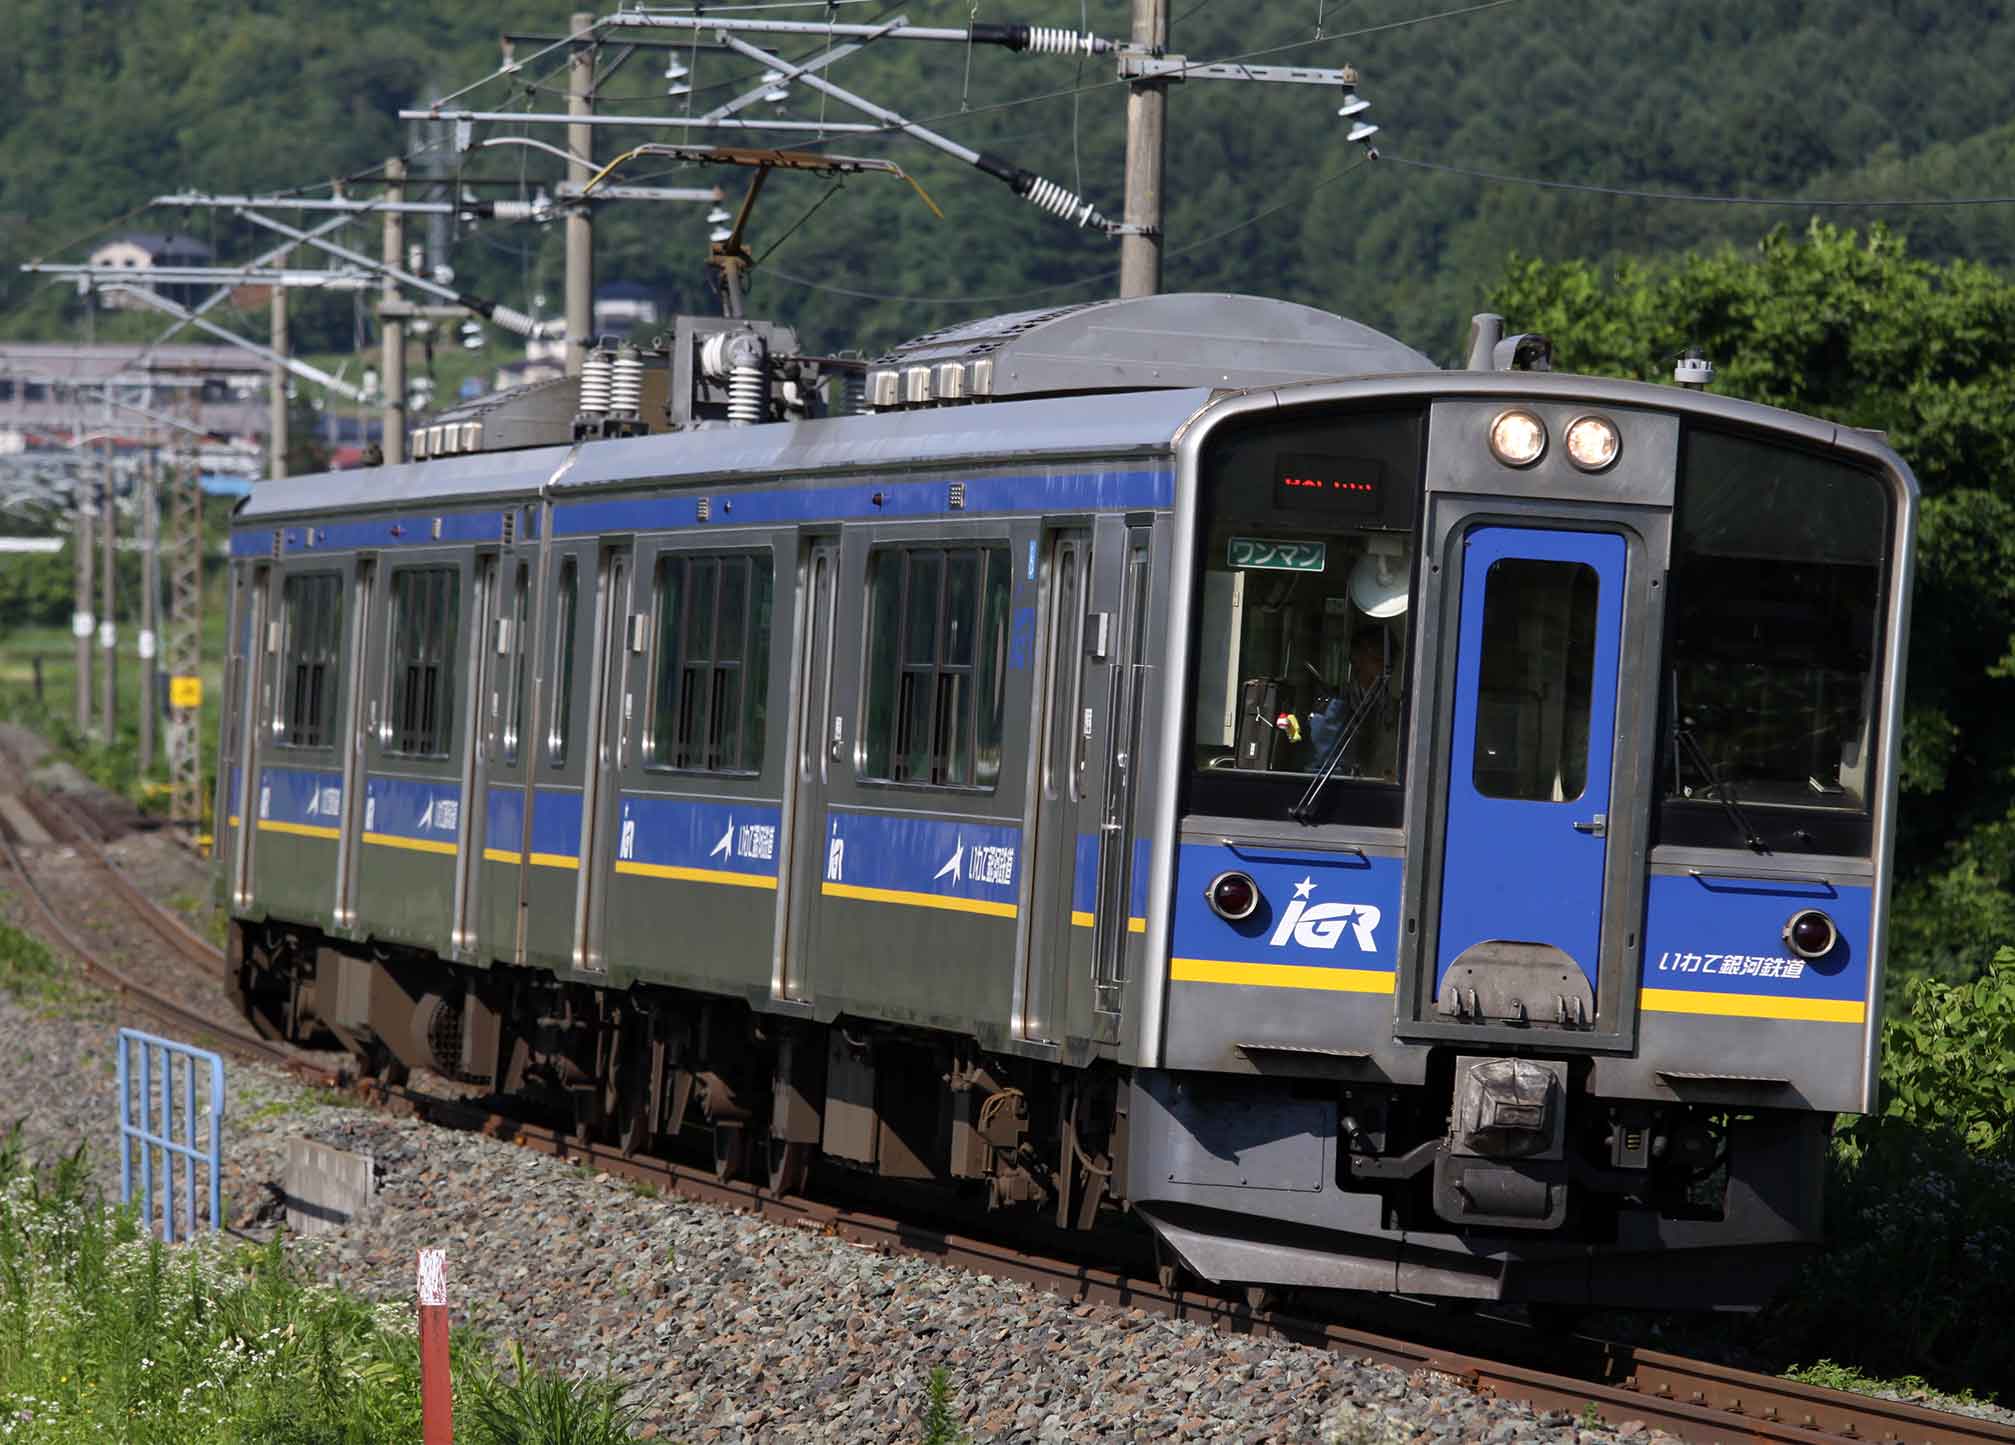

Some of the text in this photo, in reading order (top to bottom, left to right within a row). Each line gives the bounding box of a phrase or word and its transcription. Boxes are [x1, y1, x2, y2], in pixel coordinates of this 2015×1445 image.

[1233, 541, 1321, 568] ワンマン
[1658, 952, 1806, 979] いわて銀河鉄道
